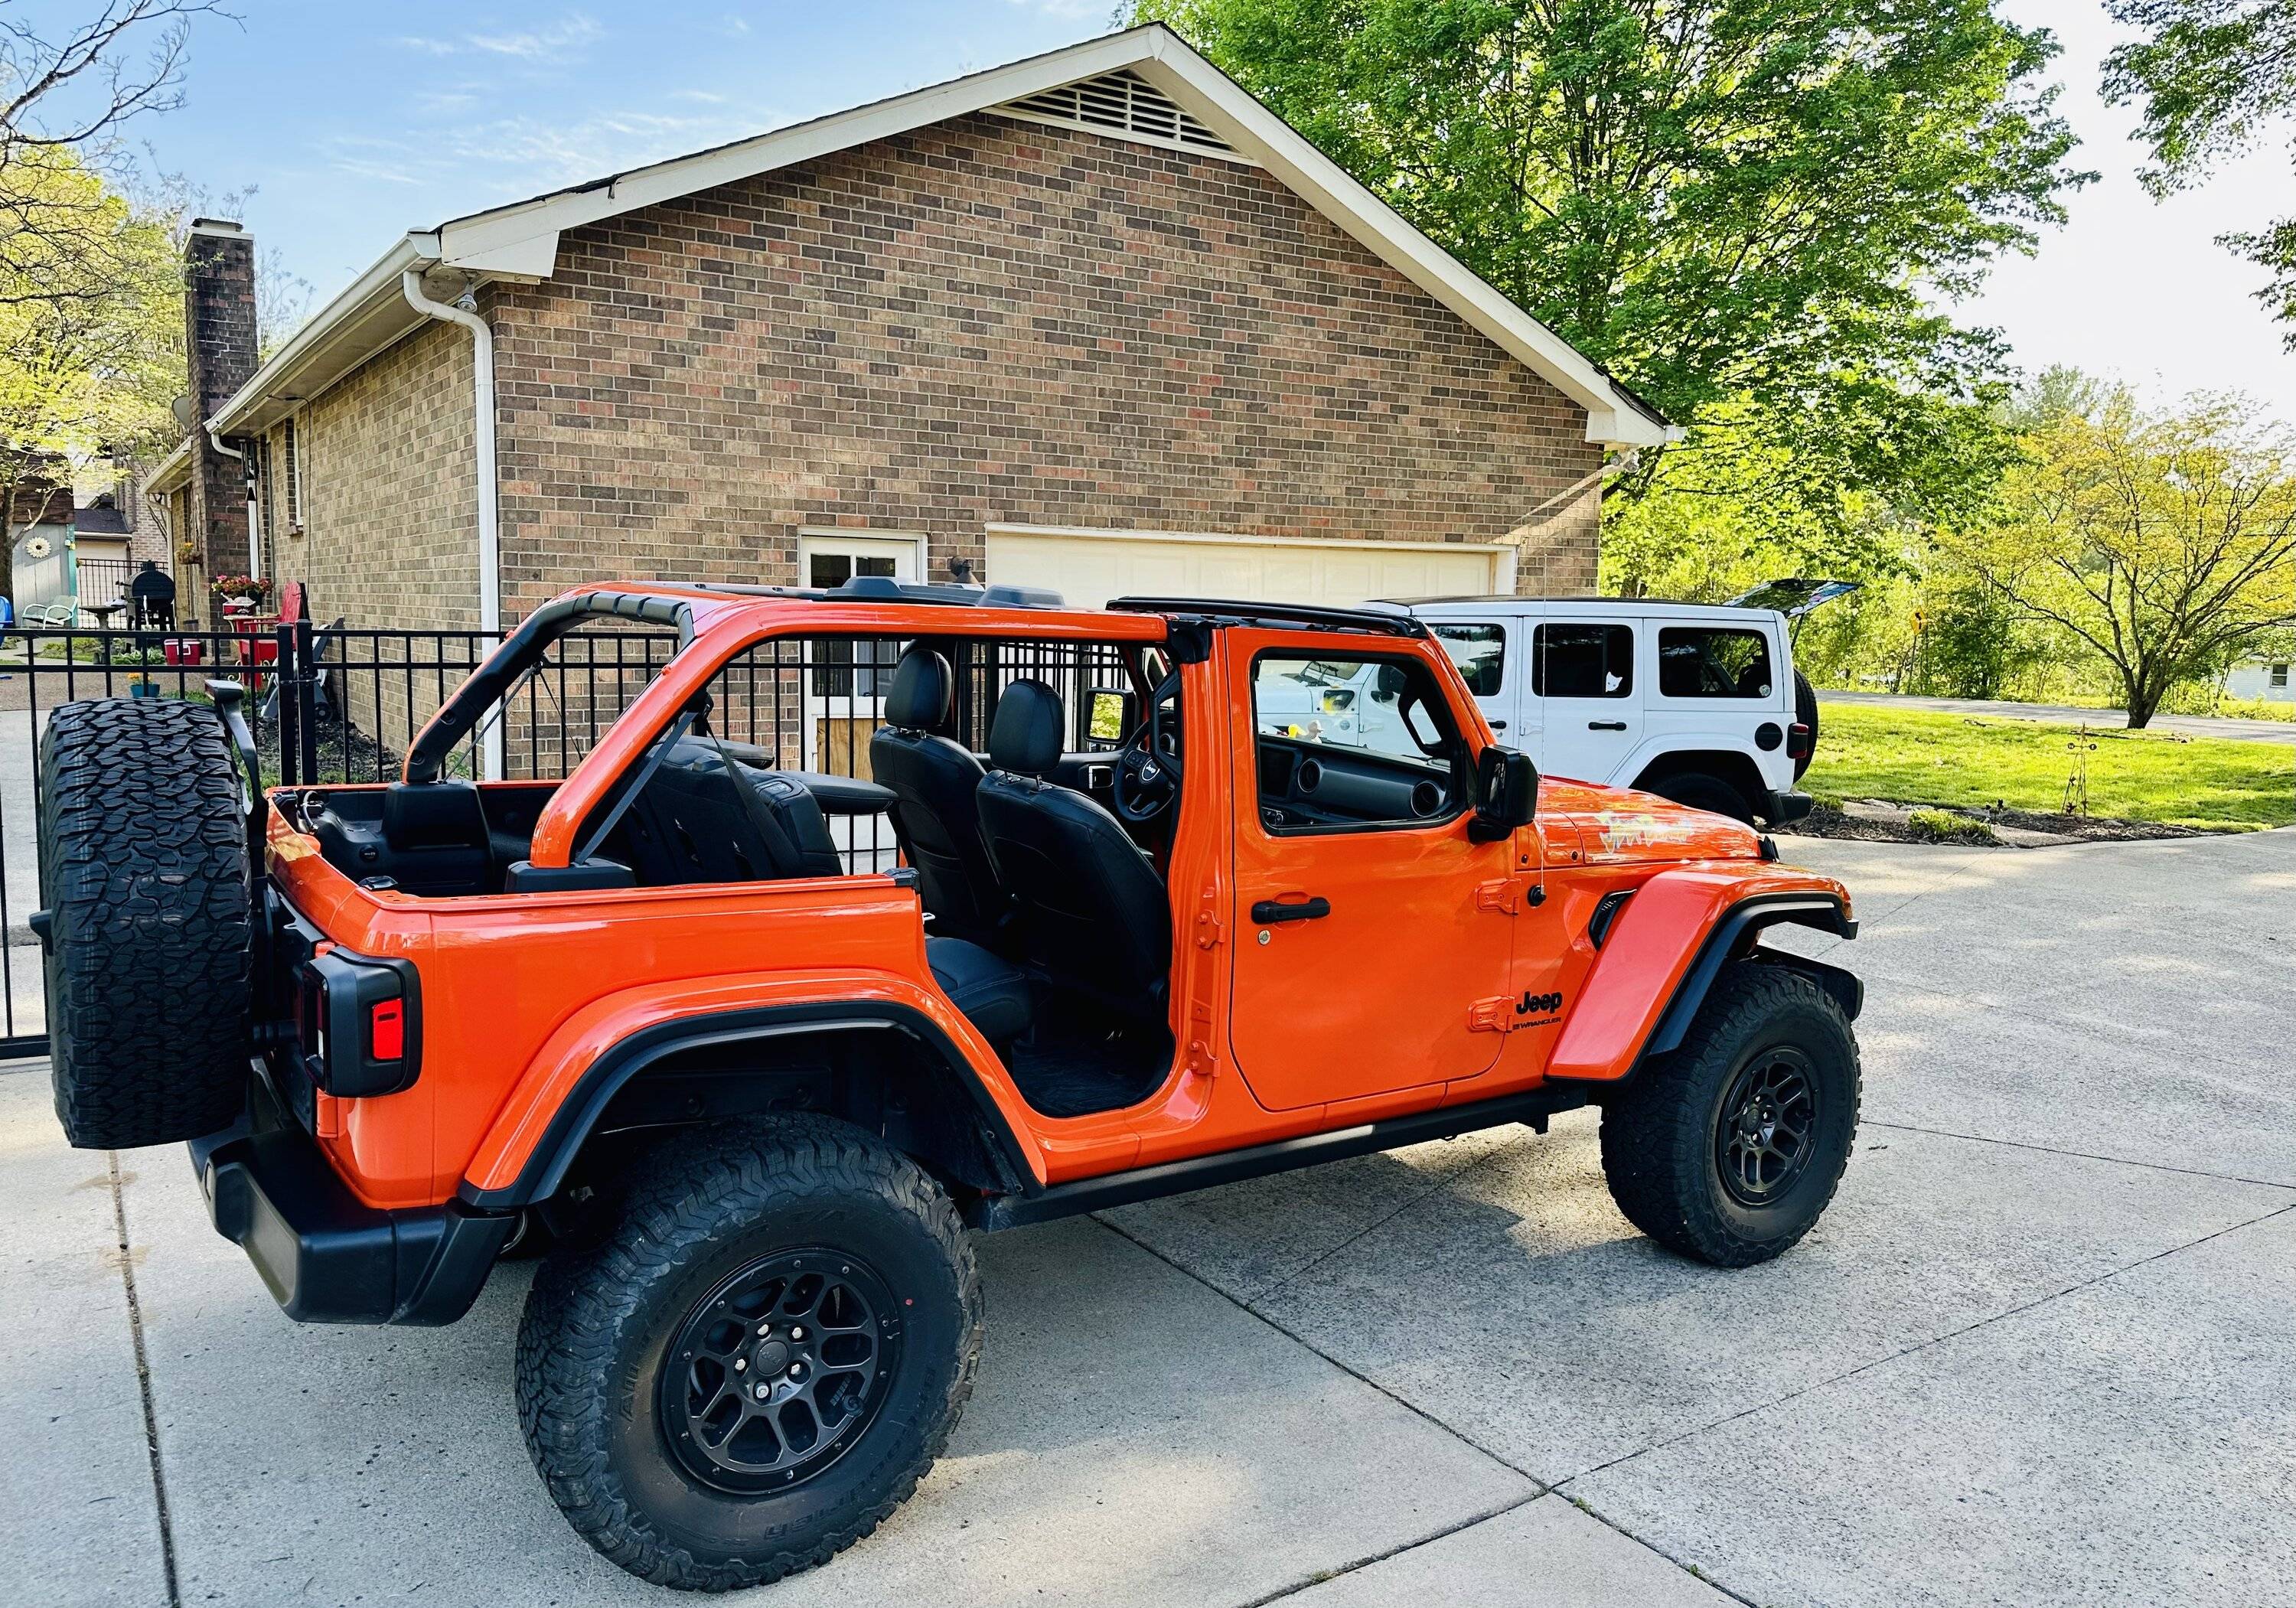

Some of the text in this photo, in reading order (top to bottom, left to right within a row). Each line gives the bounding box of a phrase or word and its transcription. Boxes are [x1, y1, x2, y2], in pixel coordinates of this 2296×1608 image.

[1146, 765, 1156, 774] Jeep
[1516, 991, 1563, 1014] Jeep
[1521, 1017, 1562, 1029] WRANGLER
